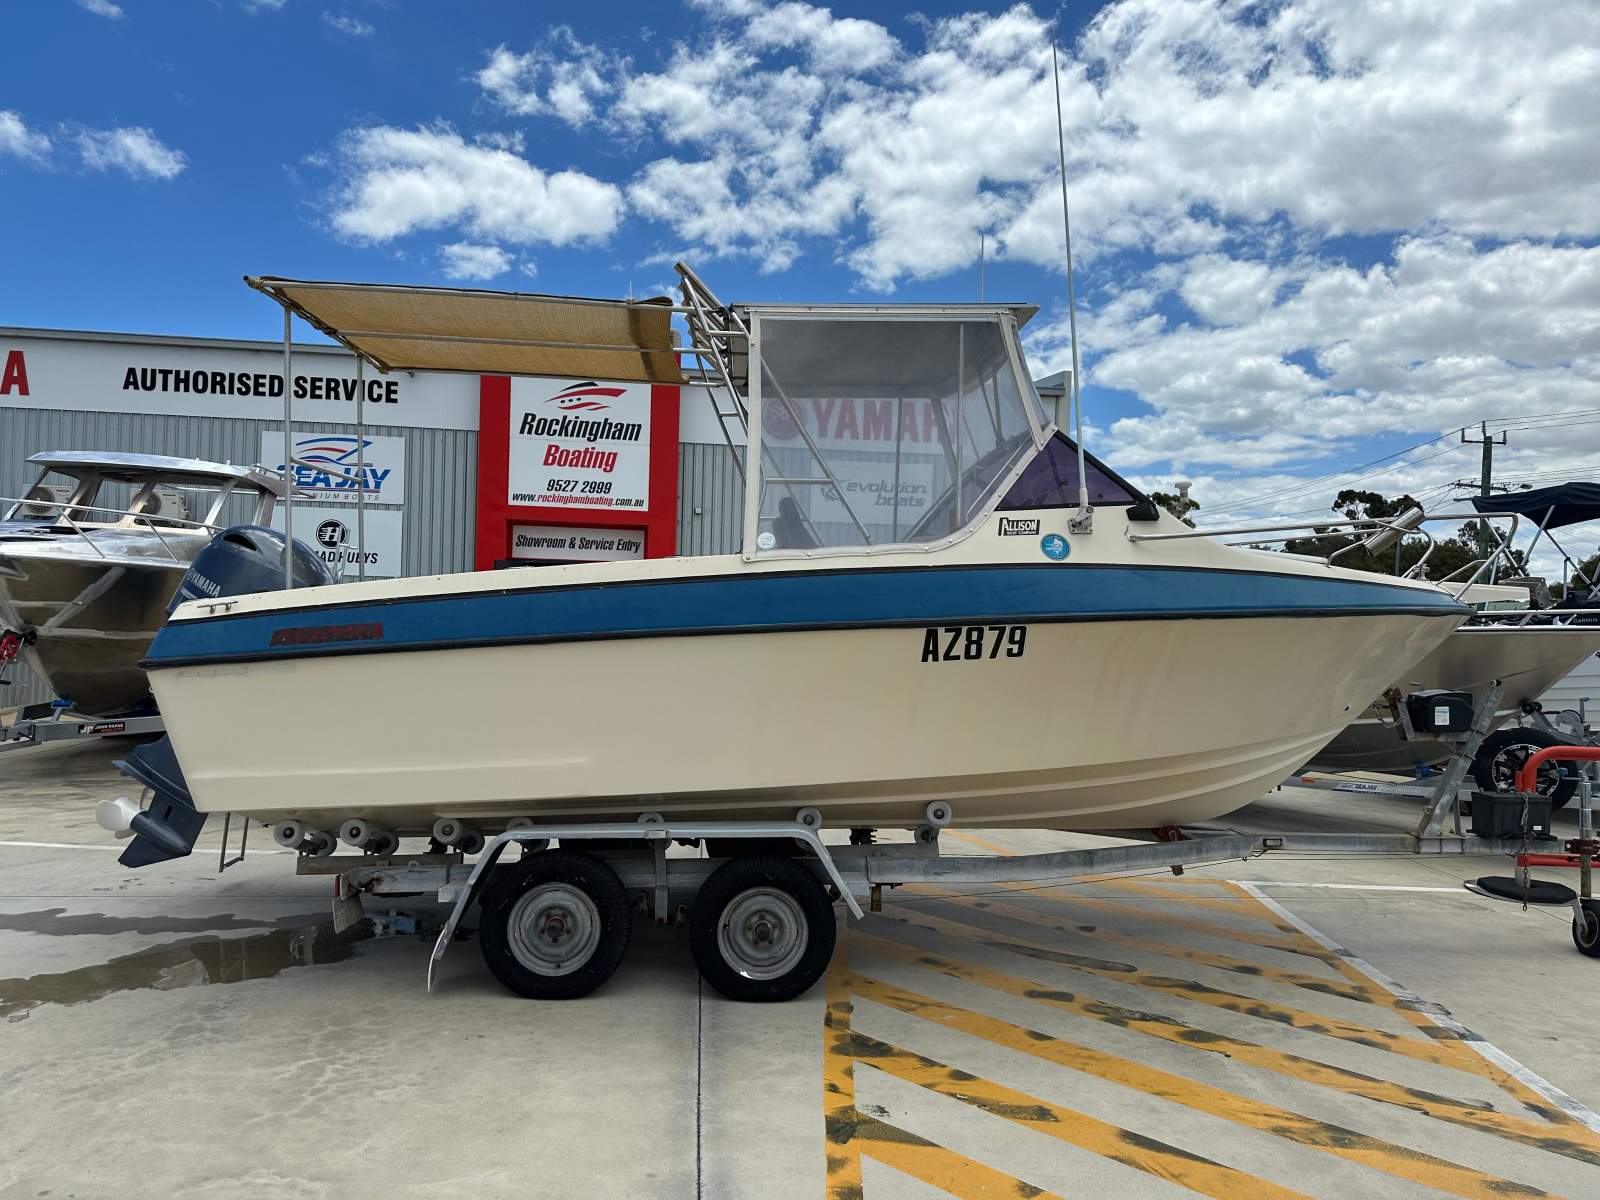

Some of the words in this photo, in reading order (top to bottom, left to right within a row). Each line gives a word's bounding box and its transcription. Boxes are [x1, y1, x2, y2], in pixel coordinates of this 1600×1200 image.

[123, 367, 284, 397] AUTHORISED
[293, 375, 399, 403] SERVICE
[519, 412, 642, 442] Rockingham
[811, 398, 948, 443] YAMAH
[543, 444, 618, 473] Boating
[547, 479, 579, 492] 9527
[581, 481, 612, 494] 2999
[847, 479, 928, 494] evolution
[344, 493, 380, 501] BOTS
[512, 493, 645, 507] www.rockinghamboating.com.au
[874, 493, 927, 507] boats
[1001, 518, 1037, 533] ALLISON
[516, 534, 567, 549] Showroom
[568, 537, 577, 549] &
[578, 537, 614, 551] Service
[616, 539, 641, 553] Entry
[315, 551, 336, 563] AD
[190, 571, 221, 598] YAMAHA
[921, 625, 1028, 663] AZ879
